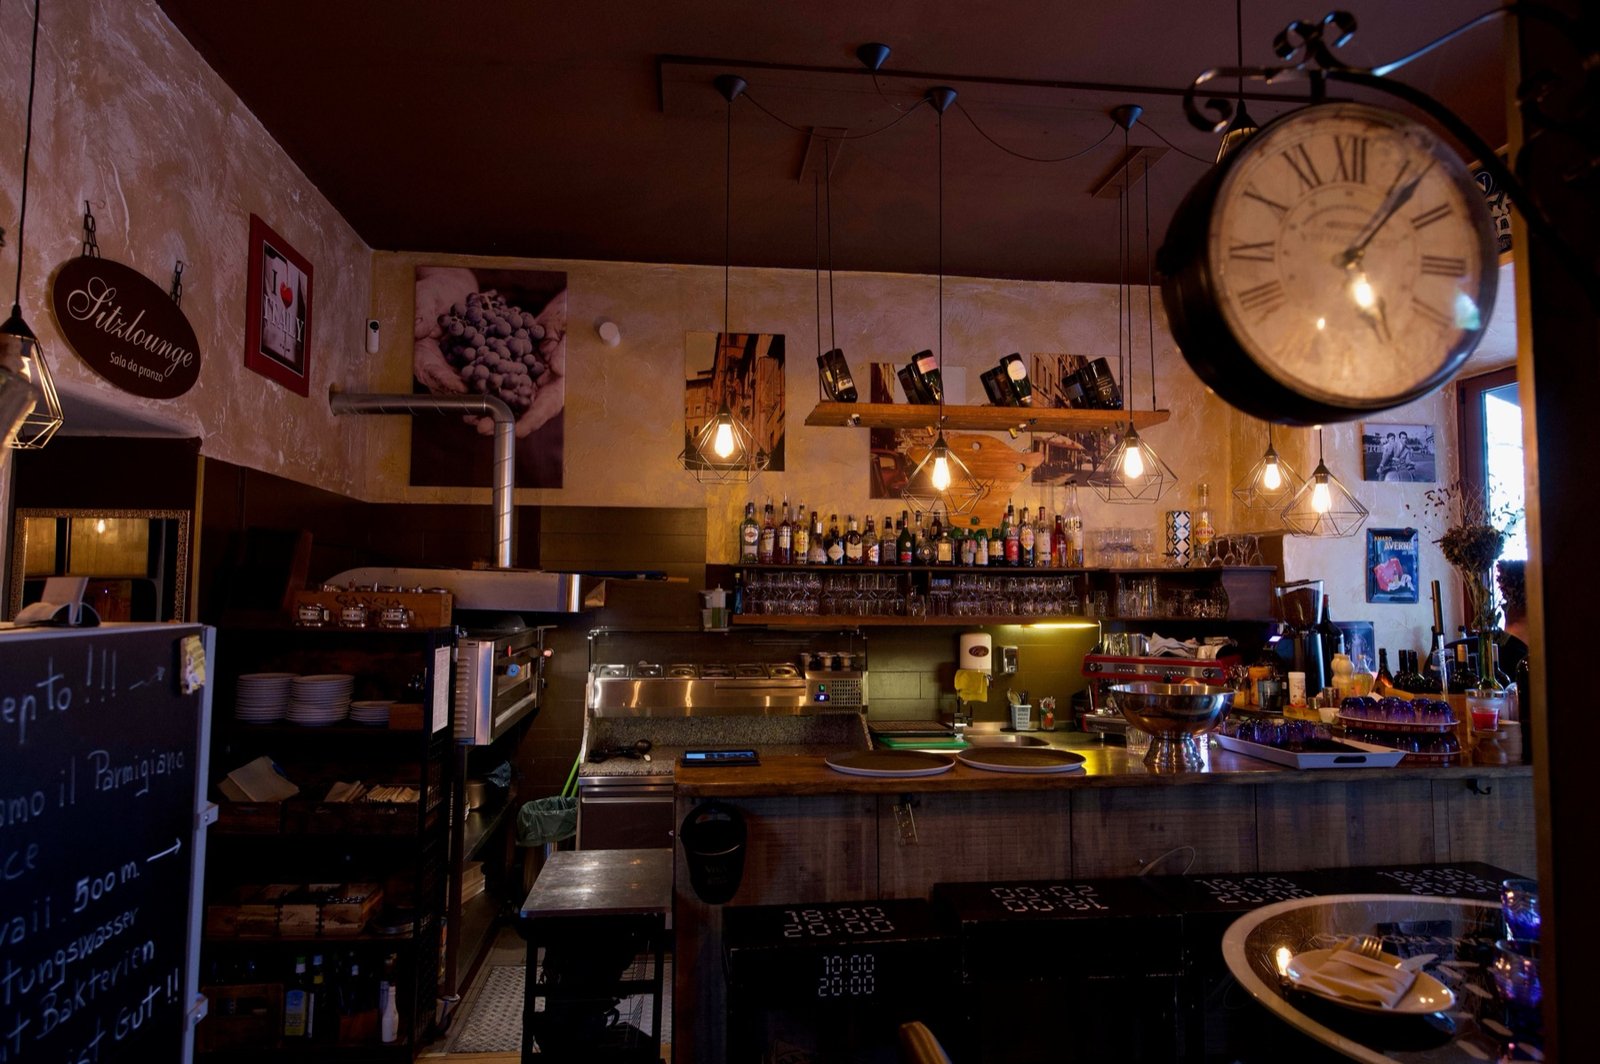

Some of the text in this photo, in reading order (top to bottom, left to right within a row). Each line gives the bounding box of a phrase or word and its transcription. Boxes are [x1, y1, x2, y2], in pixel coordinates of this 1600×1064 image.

[66, 275, 194, 378] Sitzlounge
[109, 351, 164, 383] Sala da pranzo
[335, 594, 401, 606] GANCIA
[58, 755, 76, 808] il
[87, 749, 185, 798] Parmigiano
[72, 871, 117, 915] 500
[783, 905, 886, 923] 18:00
[783, 918, 895, 938] 20:00
[821, 953, 875, 976] 10:00
[817, 975, 875, 998] 20:00
